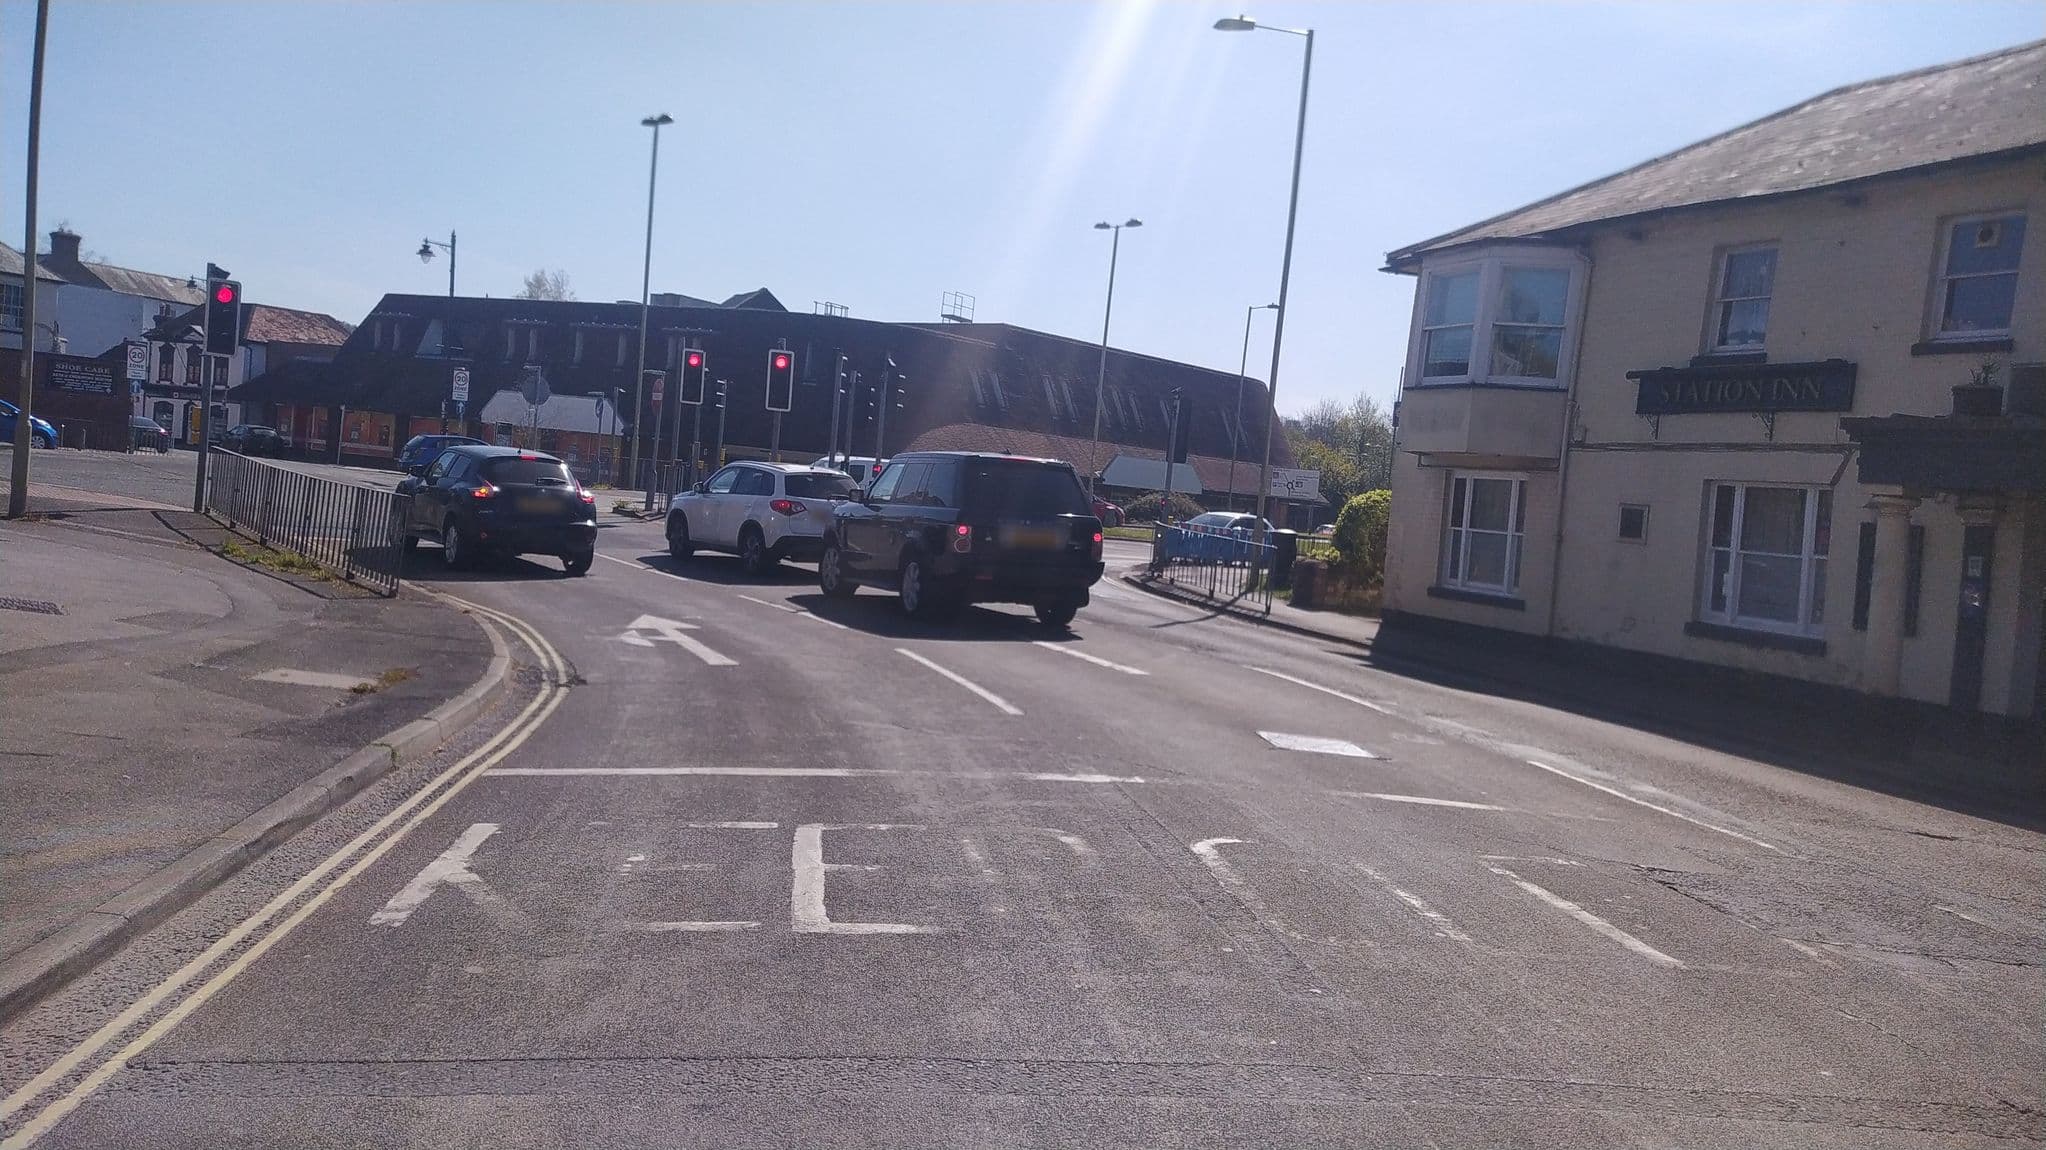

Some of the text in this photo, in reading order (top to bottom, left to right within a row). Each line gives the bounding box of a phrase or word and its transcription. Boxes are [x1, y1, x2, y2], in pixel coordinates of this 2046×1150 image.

[55, 362, 81, 371] SHOE
[84, 366, 111, 374] CARE
[1662, 376, 1821, 401] STATION INN
